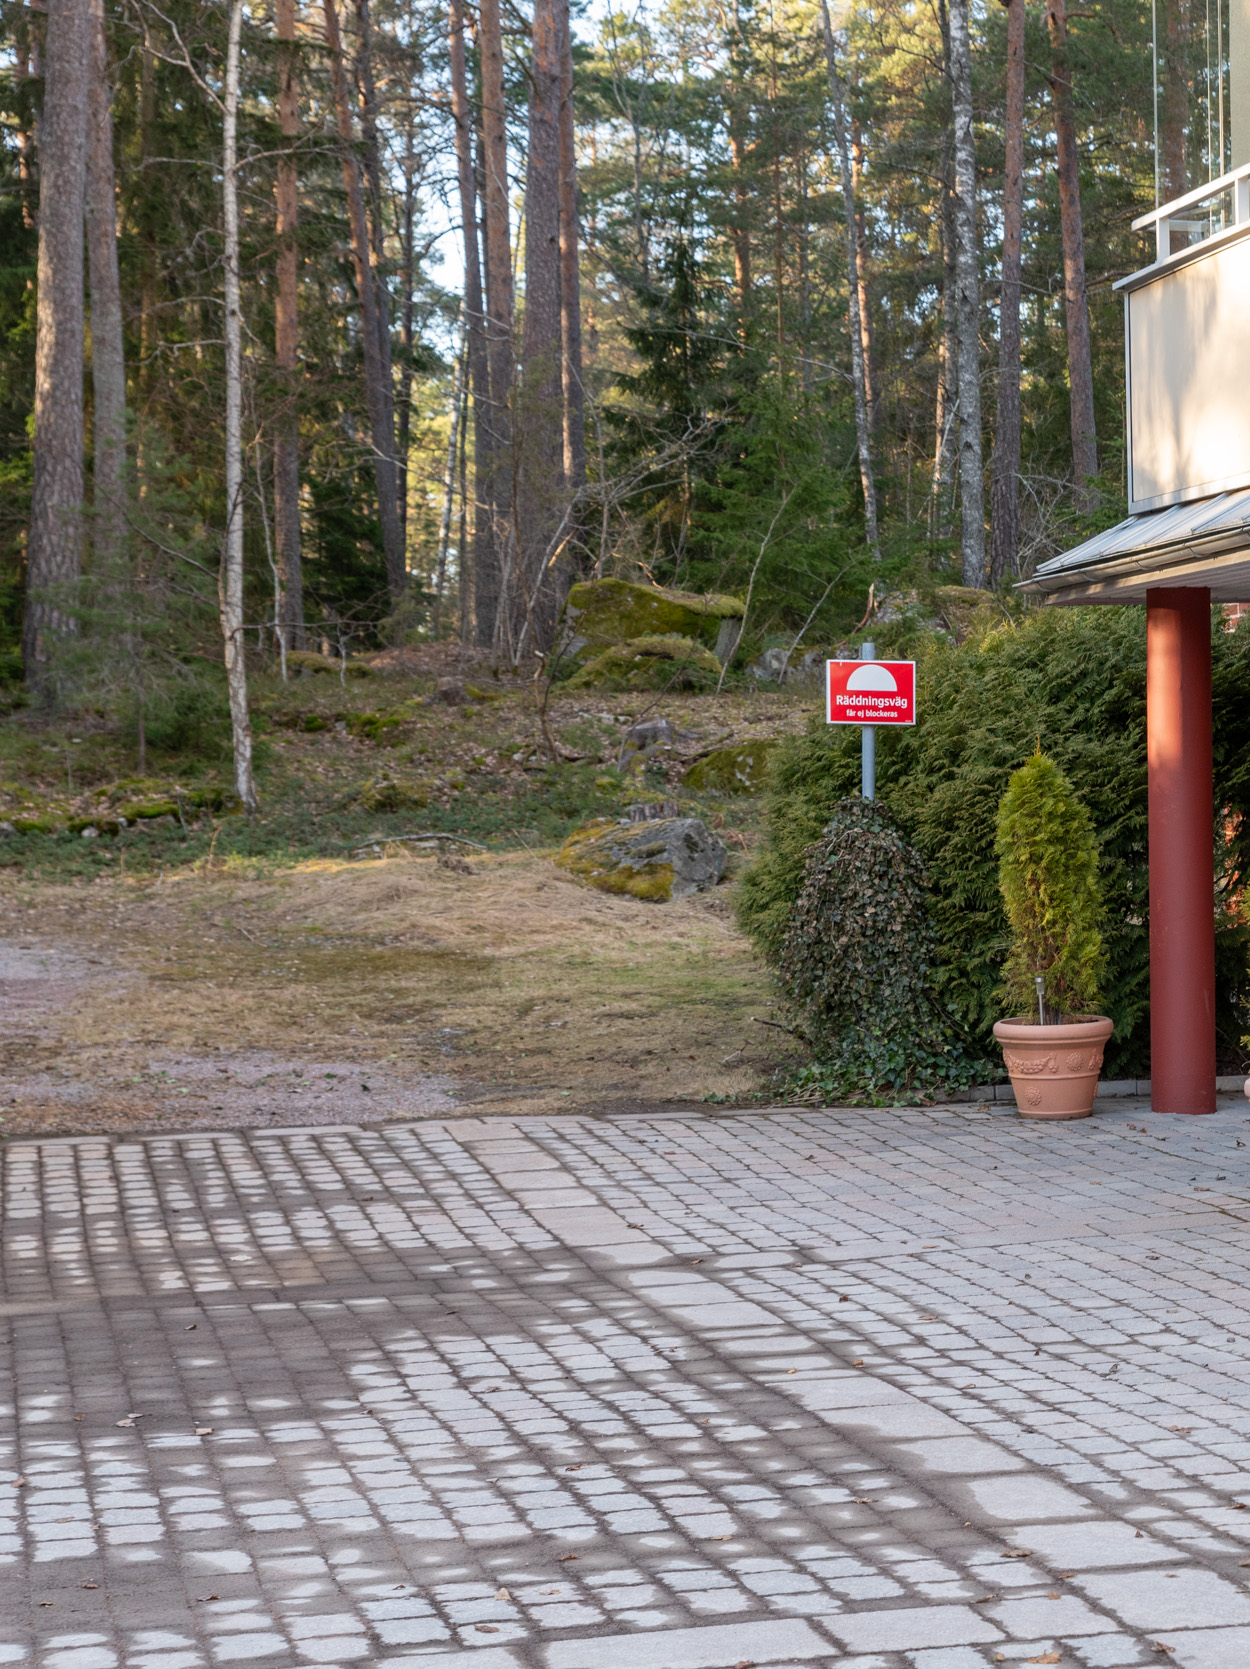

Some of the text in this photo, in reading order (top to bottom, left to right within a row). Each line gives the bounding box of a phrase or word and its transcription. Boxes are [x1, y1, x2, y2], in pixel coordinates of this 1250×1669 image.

[836, 695, 908, 709] Räddningsväg
[846, 709, 898, 718] får ej blockeras
